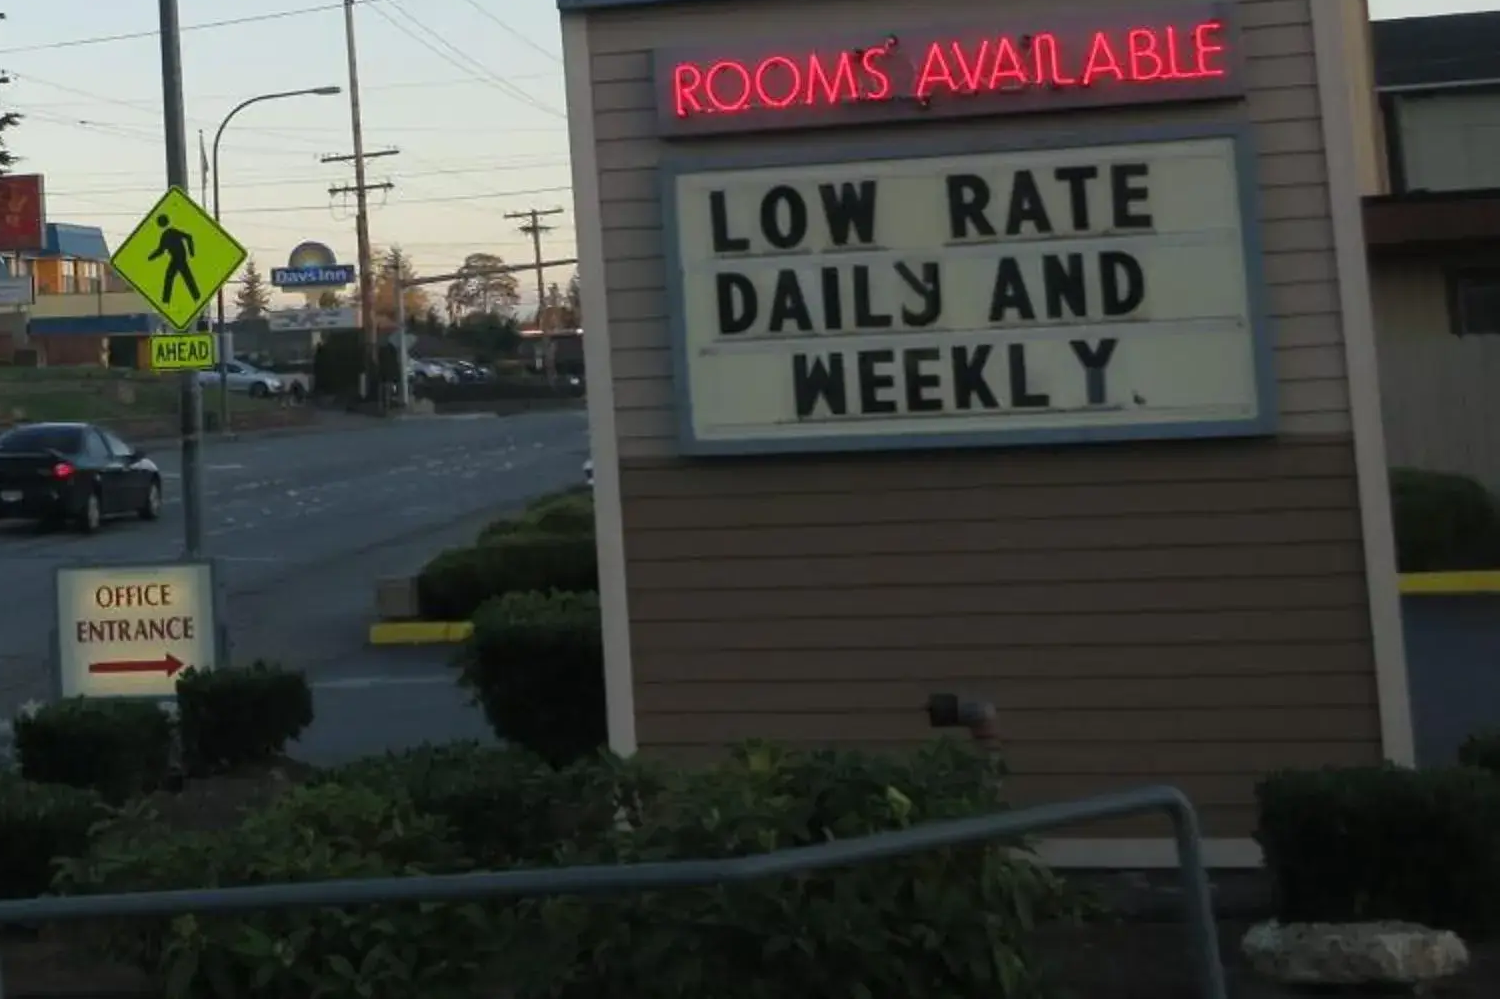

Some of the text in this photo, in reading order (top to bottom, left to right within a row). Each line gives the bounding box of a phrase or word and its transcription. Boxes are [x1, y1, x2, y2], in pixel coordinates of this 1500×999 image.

[674, 22, 1224, 115] ROOMS AVAILABLE
[709, 163, 1153, 252] LOW RATE
[716, 251, 1146, 334] DAILY AND
[156, 341, 209, 363] AHEAD
[95, 584, 172, 608] OFFICE
[76, 616, 194, 643] ENTRANCE
